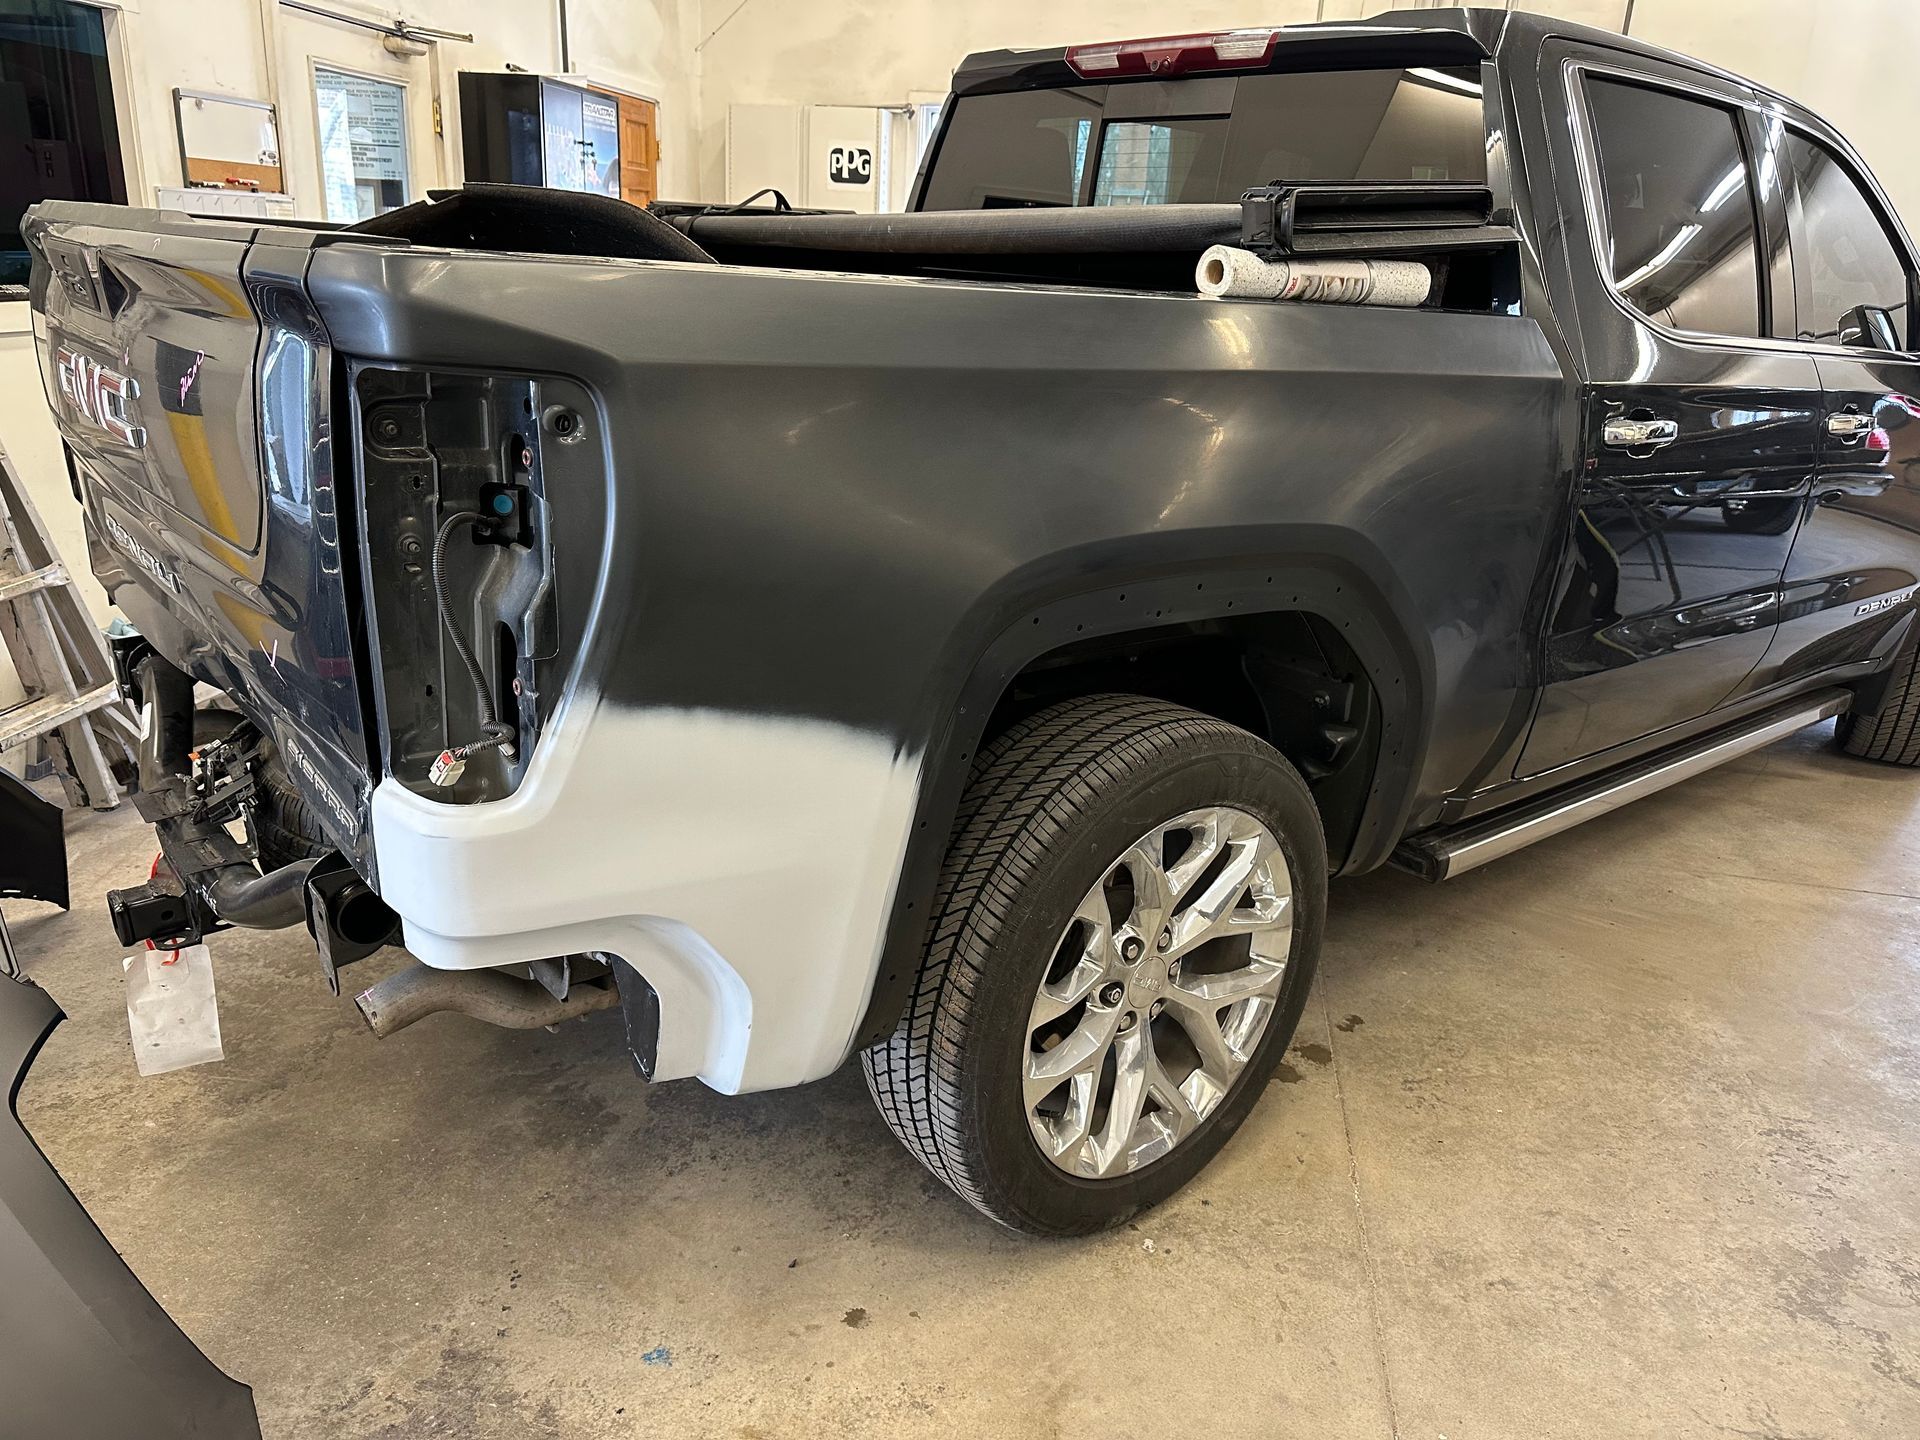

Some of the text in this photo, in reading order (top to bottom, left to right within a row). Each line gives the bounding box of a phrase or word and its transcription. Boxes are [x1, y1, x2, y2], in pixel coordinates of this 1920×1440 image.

[831, 147, 871, 180] PPG
[57, 345, 147, 449] GMC
[1854, 591, 1914, 616] DENALI
[287, 738, 358, 842] SIERRA
